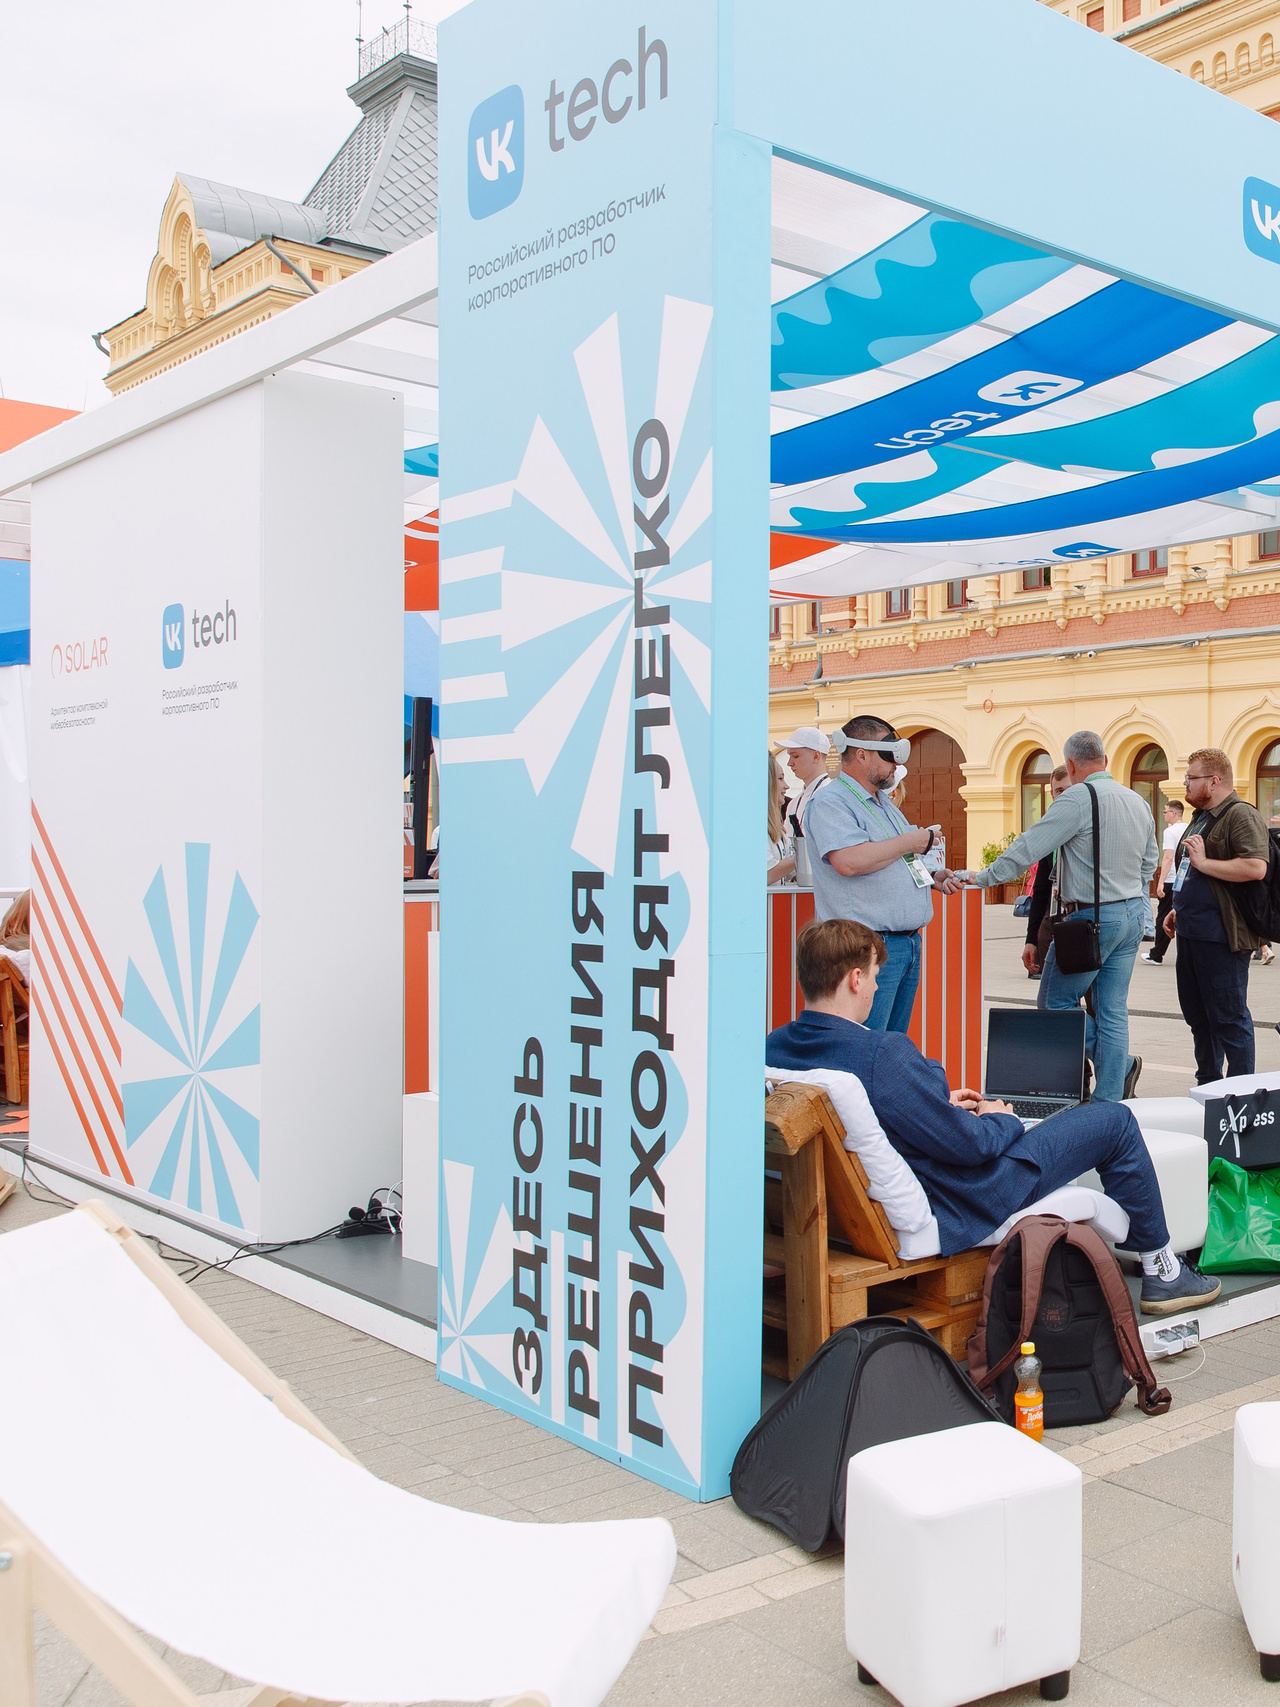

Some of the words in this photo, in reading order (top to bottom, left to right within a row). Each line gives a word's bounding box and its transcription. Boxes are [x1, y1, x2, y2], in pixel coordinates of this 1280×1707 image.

[544, 25, 668, 152] tech
[468, 228, 554, 284] Российский
[558, 184, 666, 248] разработчик
[468, 249, 588, 312] корпоративного
[592, 233, 616, 260] ПО
[874, 411, 1001, 448] tech
[192, 599, 236, 648] tech
[633, 418, 671, 790] ЛЕГКО
[65, 636, 108, 673] SOLAR
[162, 685, 197, 700] Российский
[197, 681, 239, 697] разработчик
[162, 701, 209, 716] корпоративного
[210, 697, 220, 709] ПО
[568, 871, 604, 1419] РЕШЕНИЯ
[629, 809, 675, 1447] ПРИХОДЯТ
[1219, 1104, 1275, 1158] eXpess
[513, 1036, 547, 1395] ЗДЕСЬ
